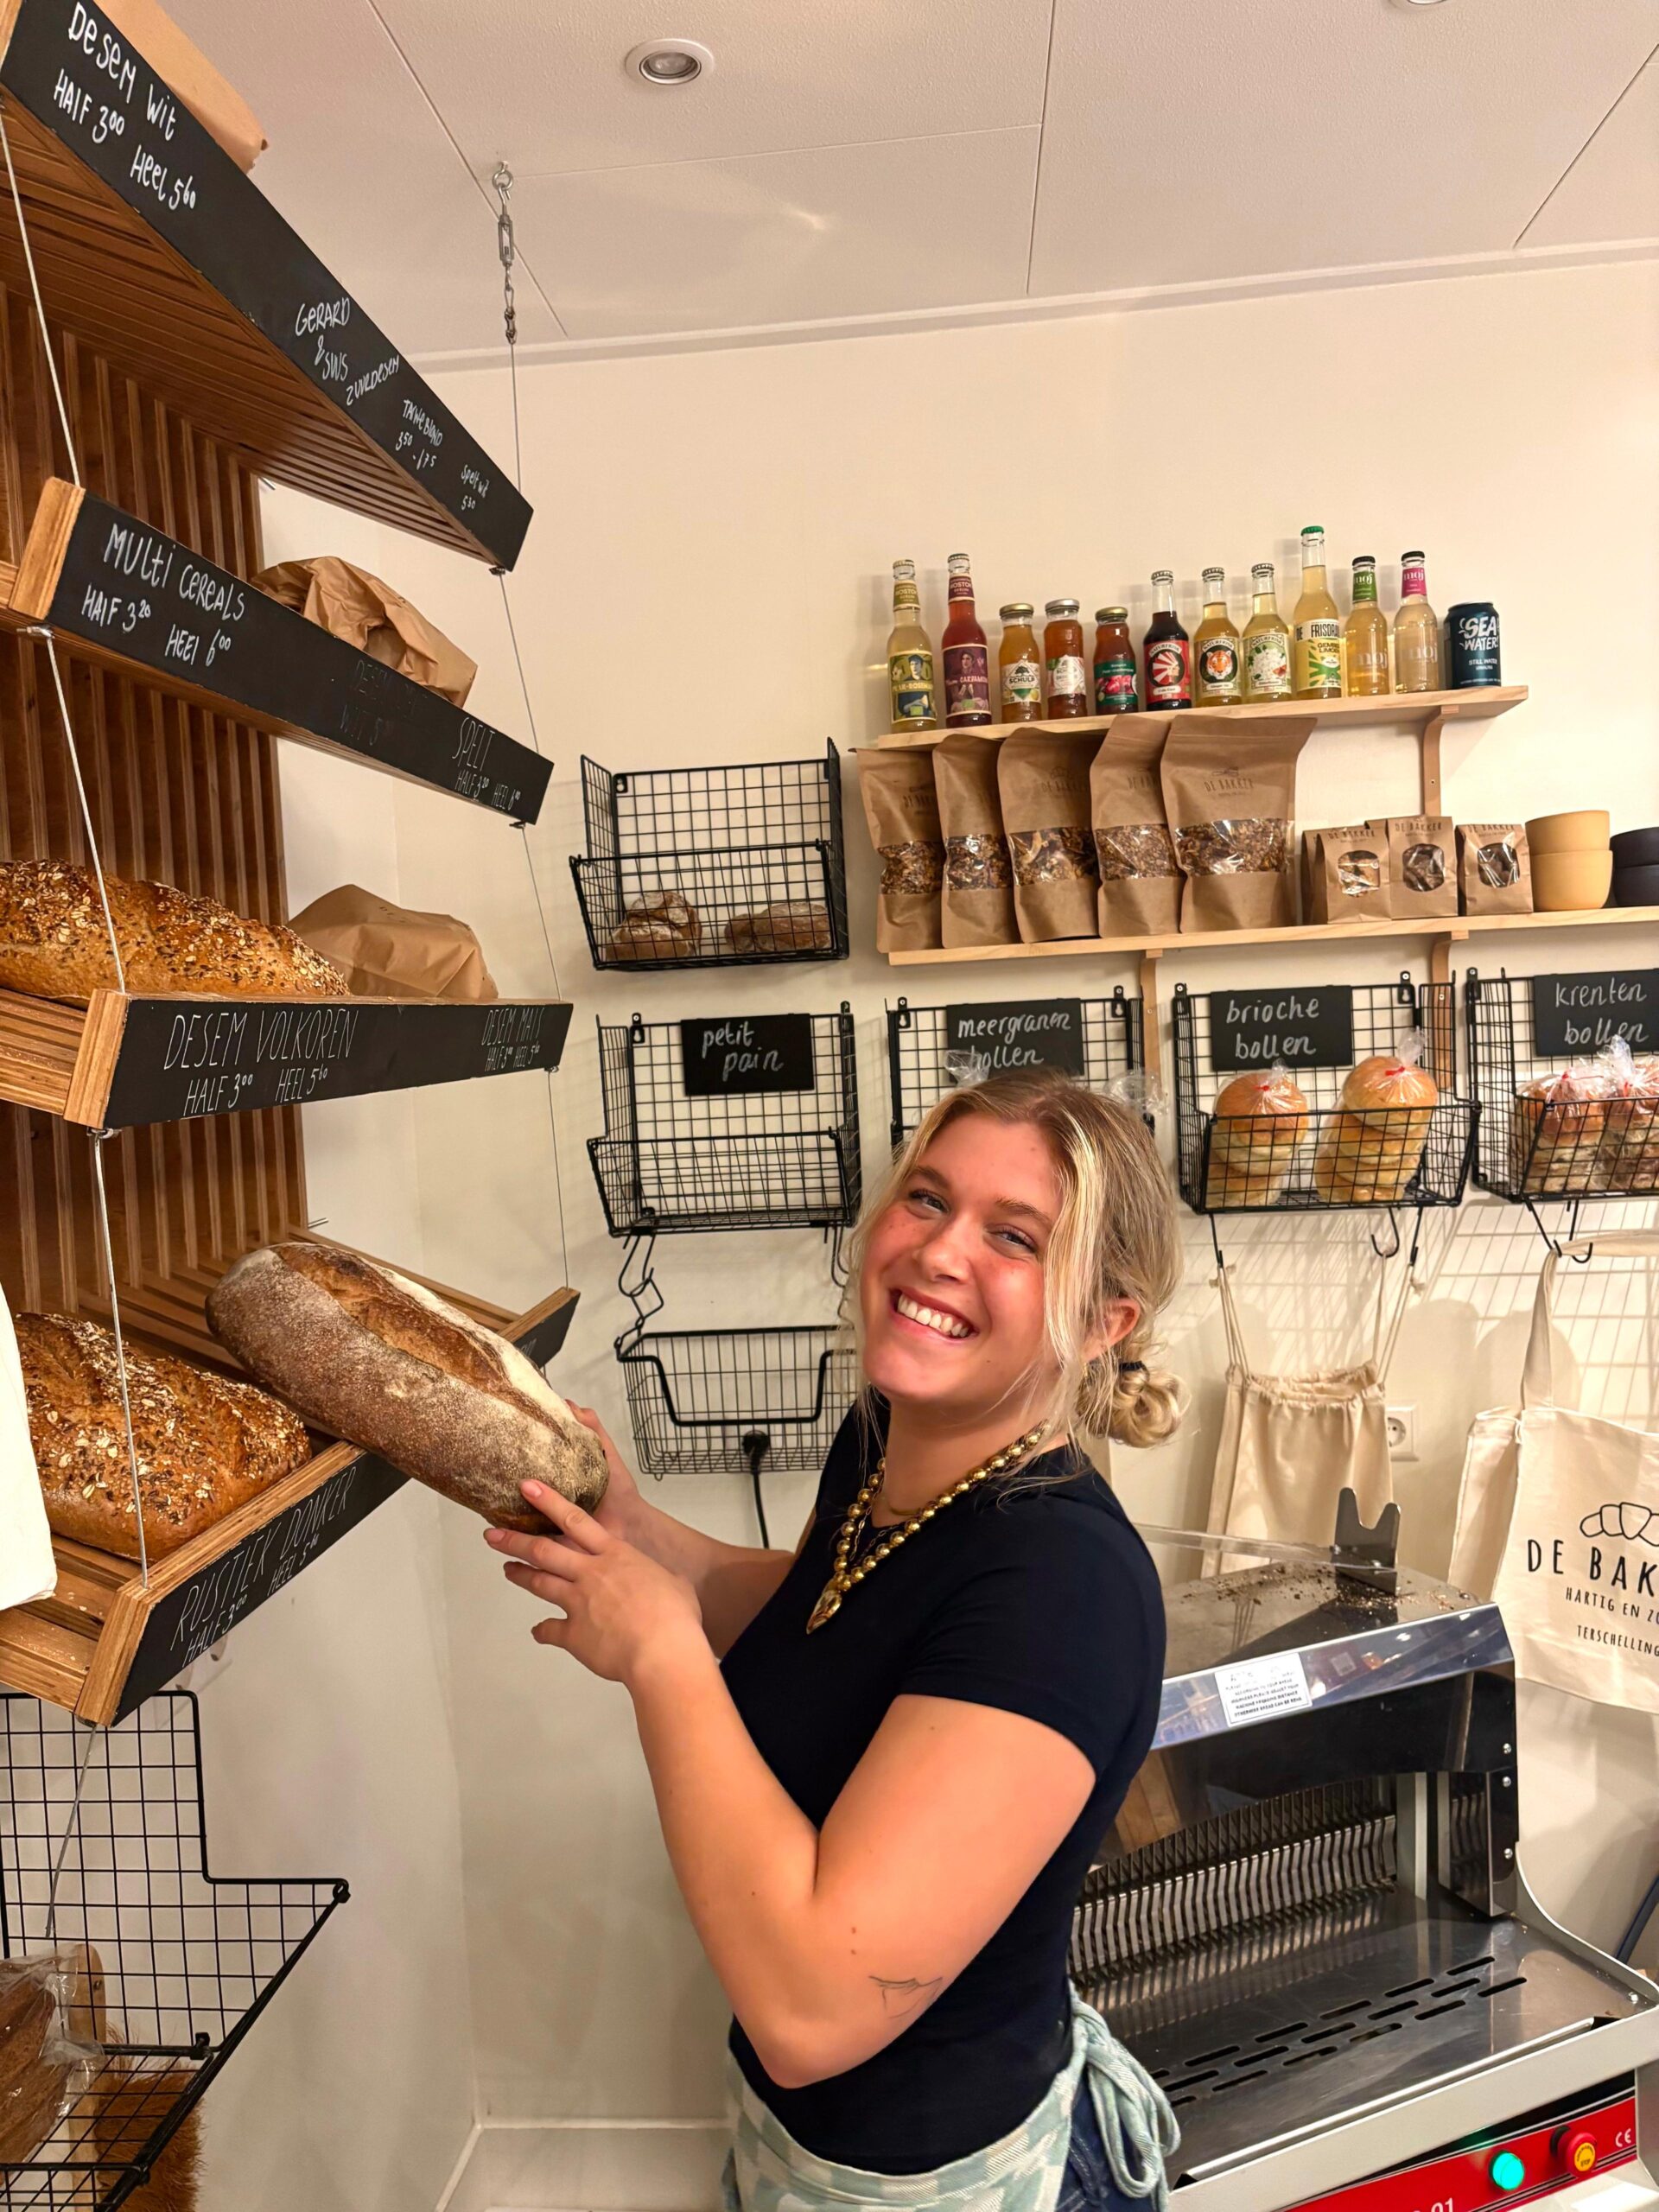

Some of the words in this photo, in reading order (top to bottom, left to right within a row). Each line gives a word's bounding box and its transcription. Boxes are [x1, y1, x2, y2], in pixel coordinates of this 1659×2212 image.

[1464, 616, 1497, 639] SEA
[451, 716, 496, 772] SPELT
[1226, 995, 1319, 1024] brioche
[1555, 976, 1648, 1008] krenten
[163, 1011, 248, 1071] DESEM
[256, 1007, 359, 1064] VOLKOREN
[480, 1007, 518, 1046] DESEM
[702, 1020, 754, 1059] petit
[1564, 1017, 1649, 1046] bollen
[722, 1046, 784, 1082] pain
[1235, 1033, 1317, 1059] bollen
[182, 1075, 230, 1116] HALF
[227, 1072, 254, 1109] 300
[275, 1066, 307, 1103] HEEL
[305, 1063, 328, 1096] 560
[169, 1522, 282, 1651] RUSTIEK
[279, 1465, 357, 1560] DONKER
[1527, 1538, 1565, 1575] DE
[181, 1610, 226, 1668] HALF
[267, 1553, 297, 1597] HEEL
[1566, 1586, 1615, 1612] HARTIG
[1623, 1602, 1640, 1618] EN
[1577, 1624, 1659, 1657] TERSCHELLING
